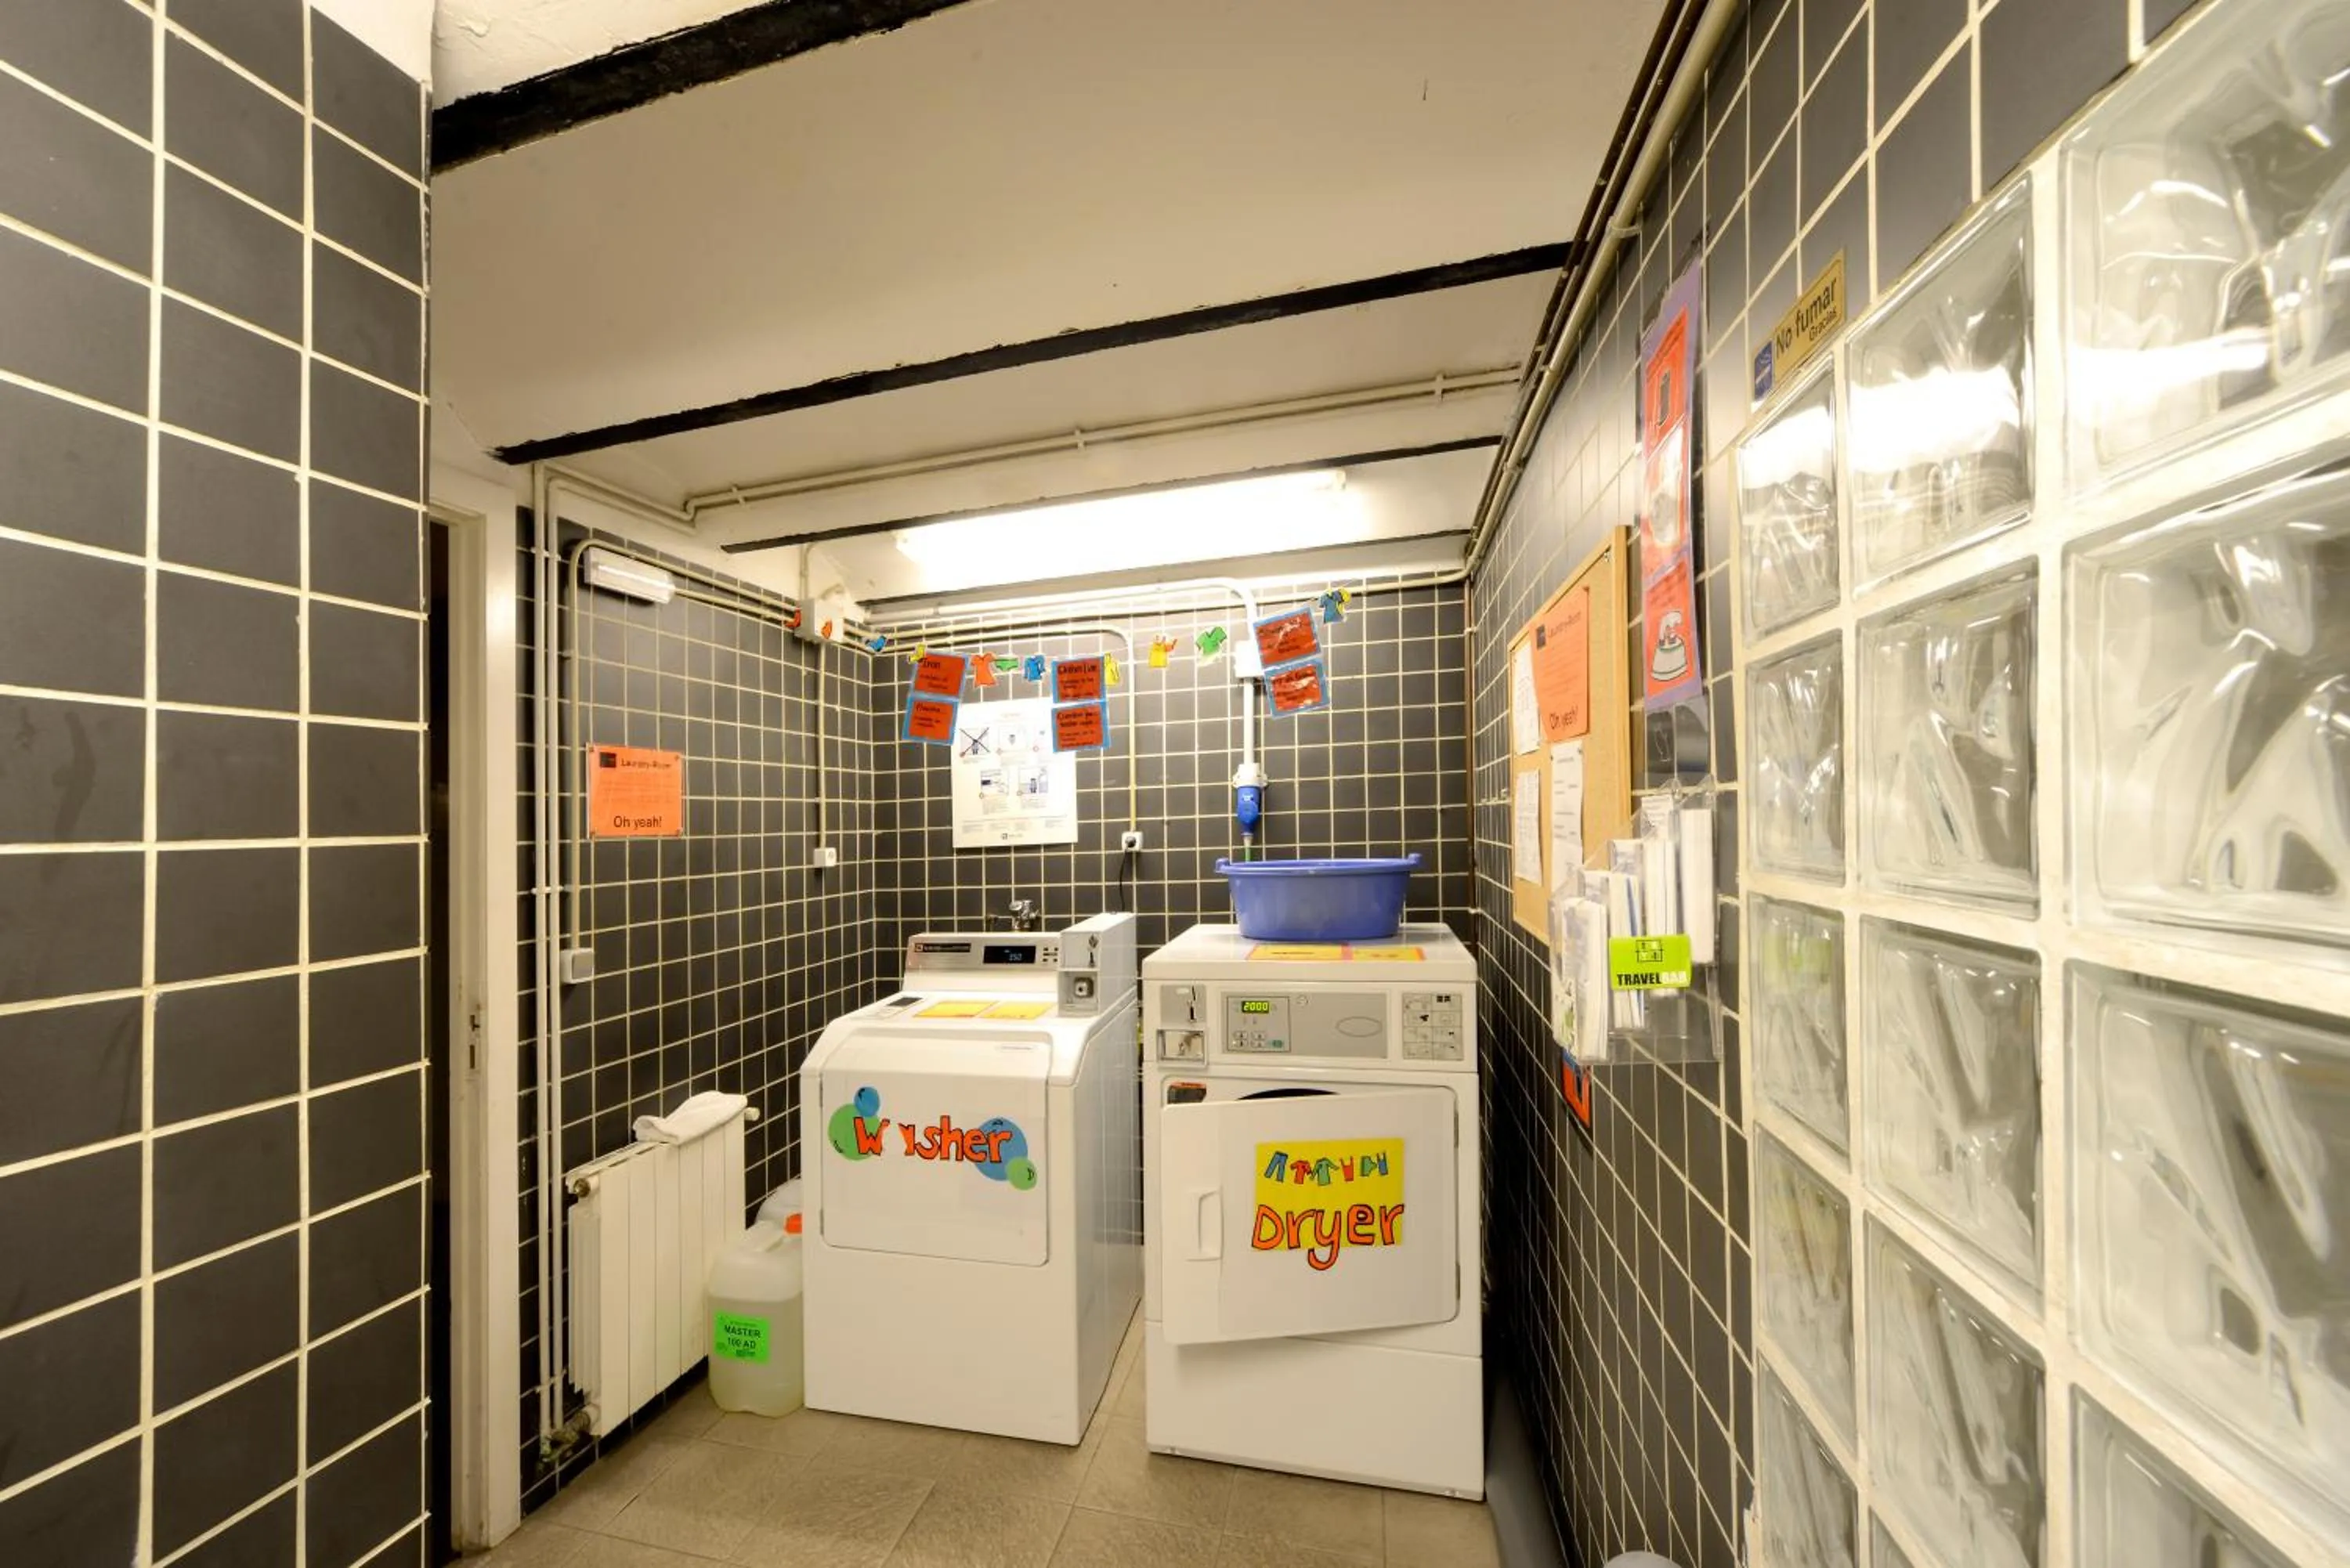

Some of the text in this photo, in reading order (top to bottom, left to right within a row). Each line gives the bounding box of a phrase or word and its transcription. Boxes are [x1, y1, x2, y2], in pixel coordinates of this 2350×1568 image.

[1776, 277, 1837, 359] No fumar
[1809, 307, 1837, 341] Gracias
[613, 815, 663, 831] Oh yeah!
[1243, 1002, 1268, 1011] 2000
[1252, 1203, 1405, 1271] Dryer
[724, 1324, 761, 1339] MASTER
